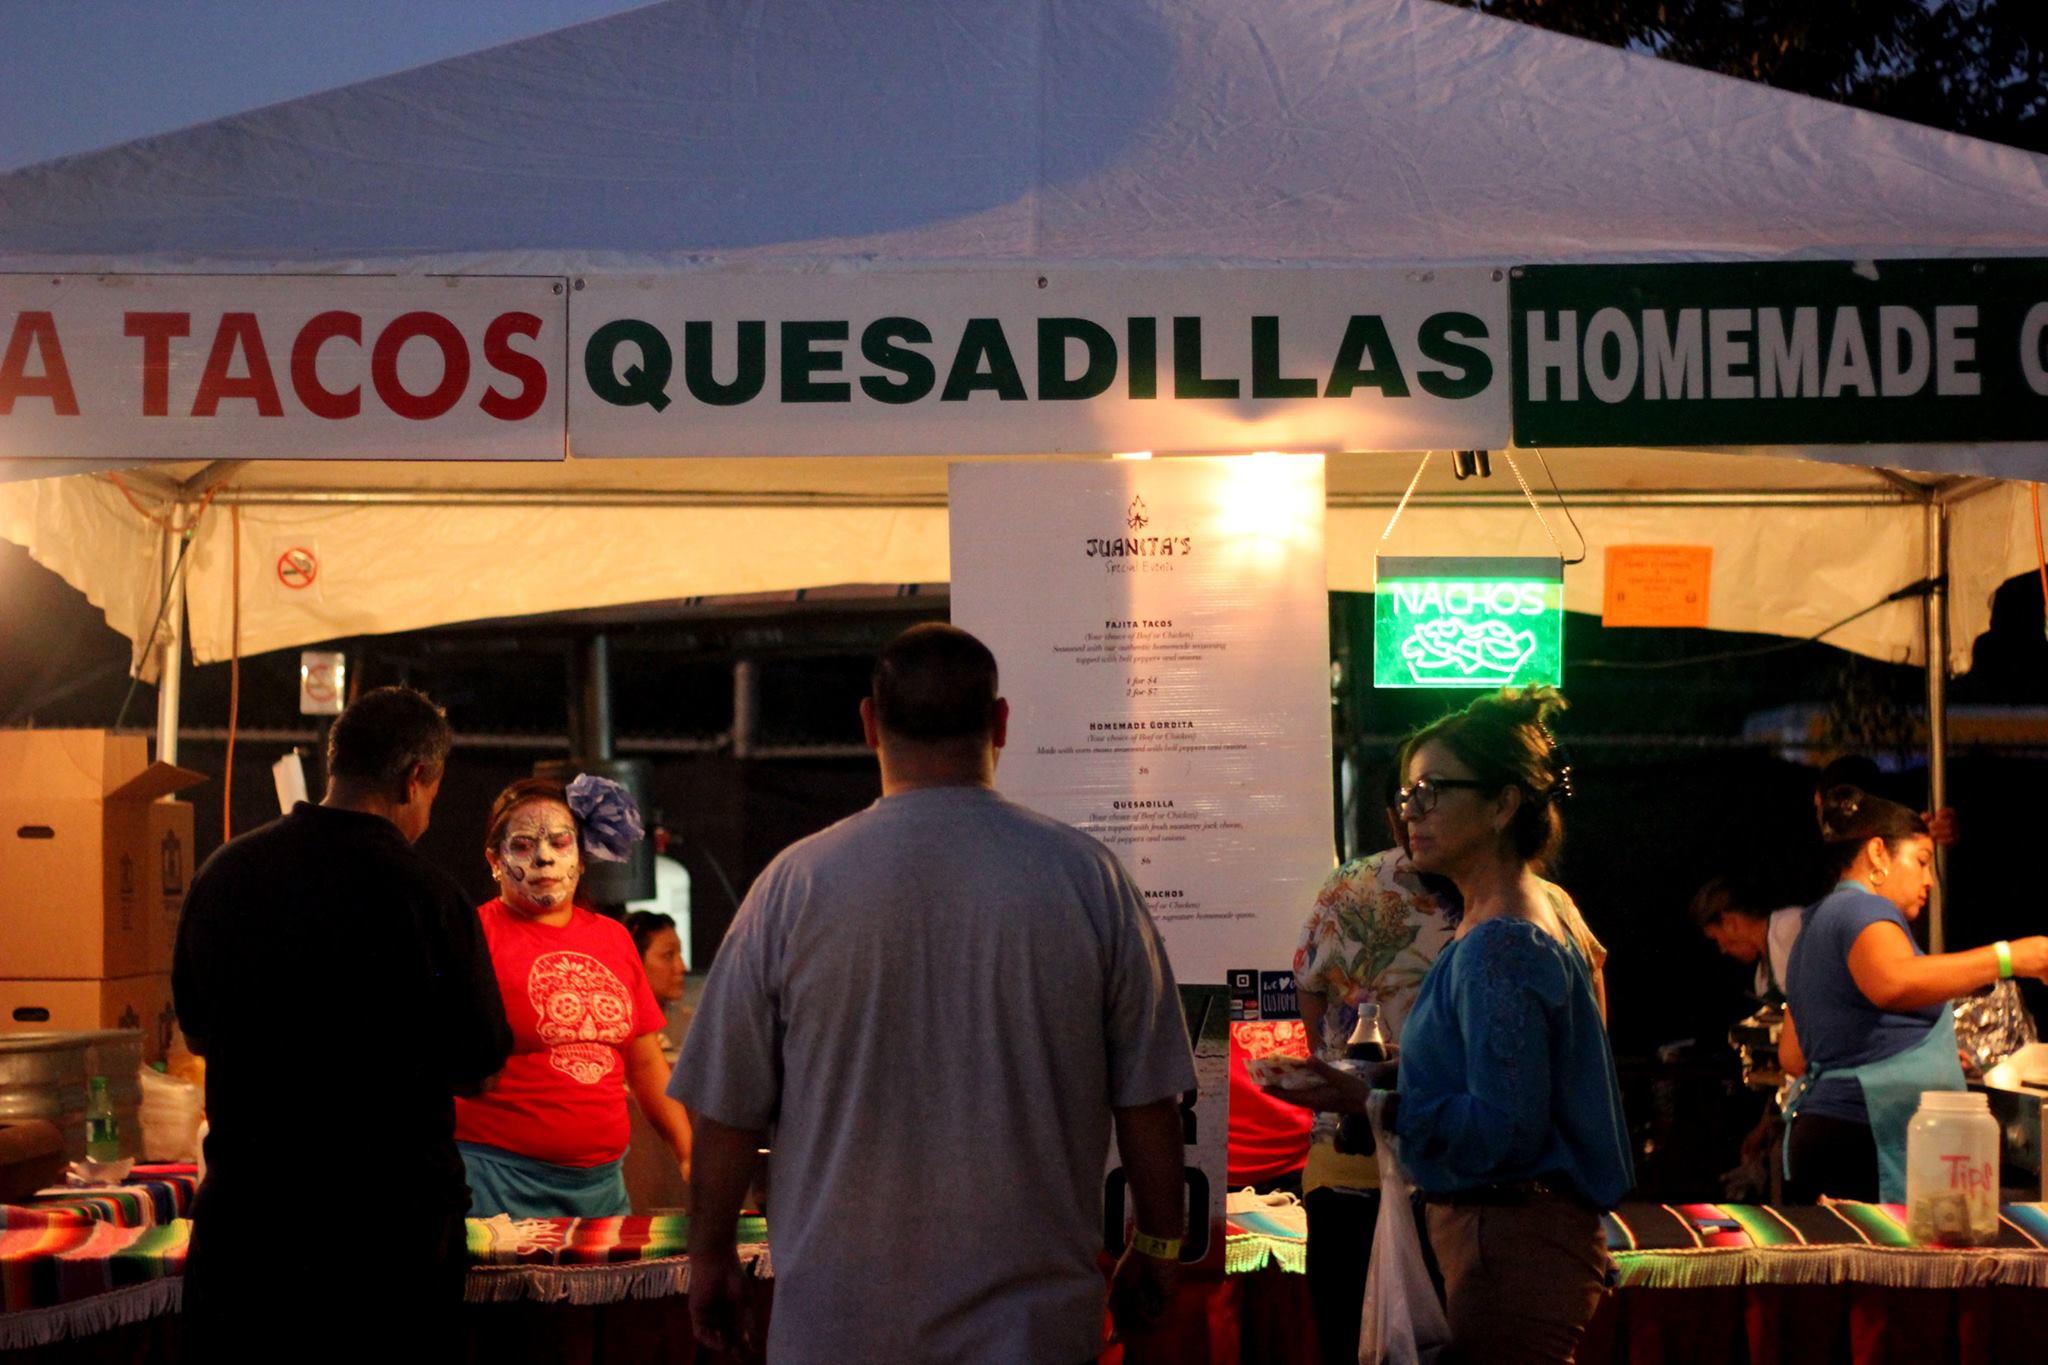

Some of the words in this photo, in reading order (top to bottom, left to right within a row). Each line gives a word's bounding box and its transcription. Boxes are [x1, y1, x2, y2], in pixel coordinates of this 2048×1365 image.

[124, 310, 549, 421] TACOS
[584, 311, 1493, 413] QUESADILLAS
[1527, 305, 1982, 403] HOMEMADE
[1086, 537, 1191, 557] JUANITA'S
[1389, 582, 1546, 615] NACHOS
[1105, 620, 1138, 629] FAJITA
[1142, 619, 1173, 628] TACOS
[1089, 721, 1146, 731] HOMEMADE
[1150, 720, 1194, 729] GORDITA
[1113, 799, 1175, 810] QUESADILLA
[1144, 889, 1184, 898] NACHOS
[1940, 1154, 1993, 1200] Tips
